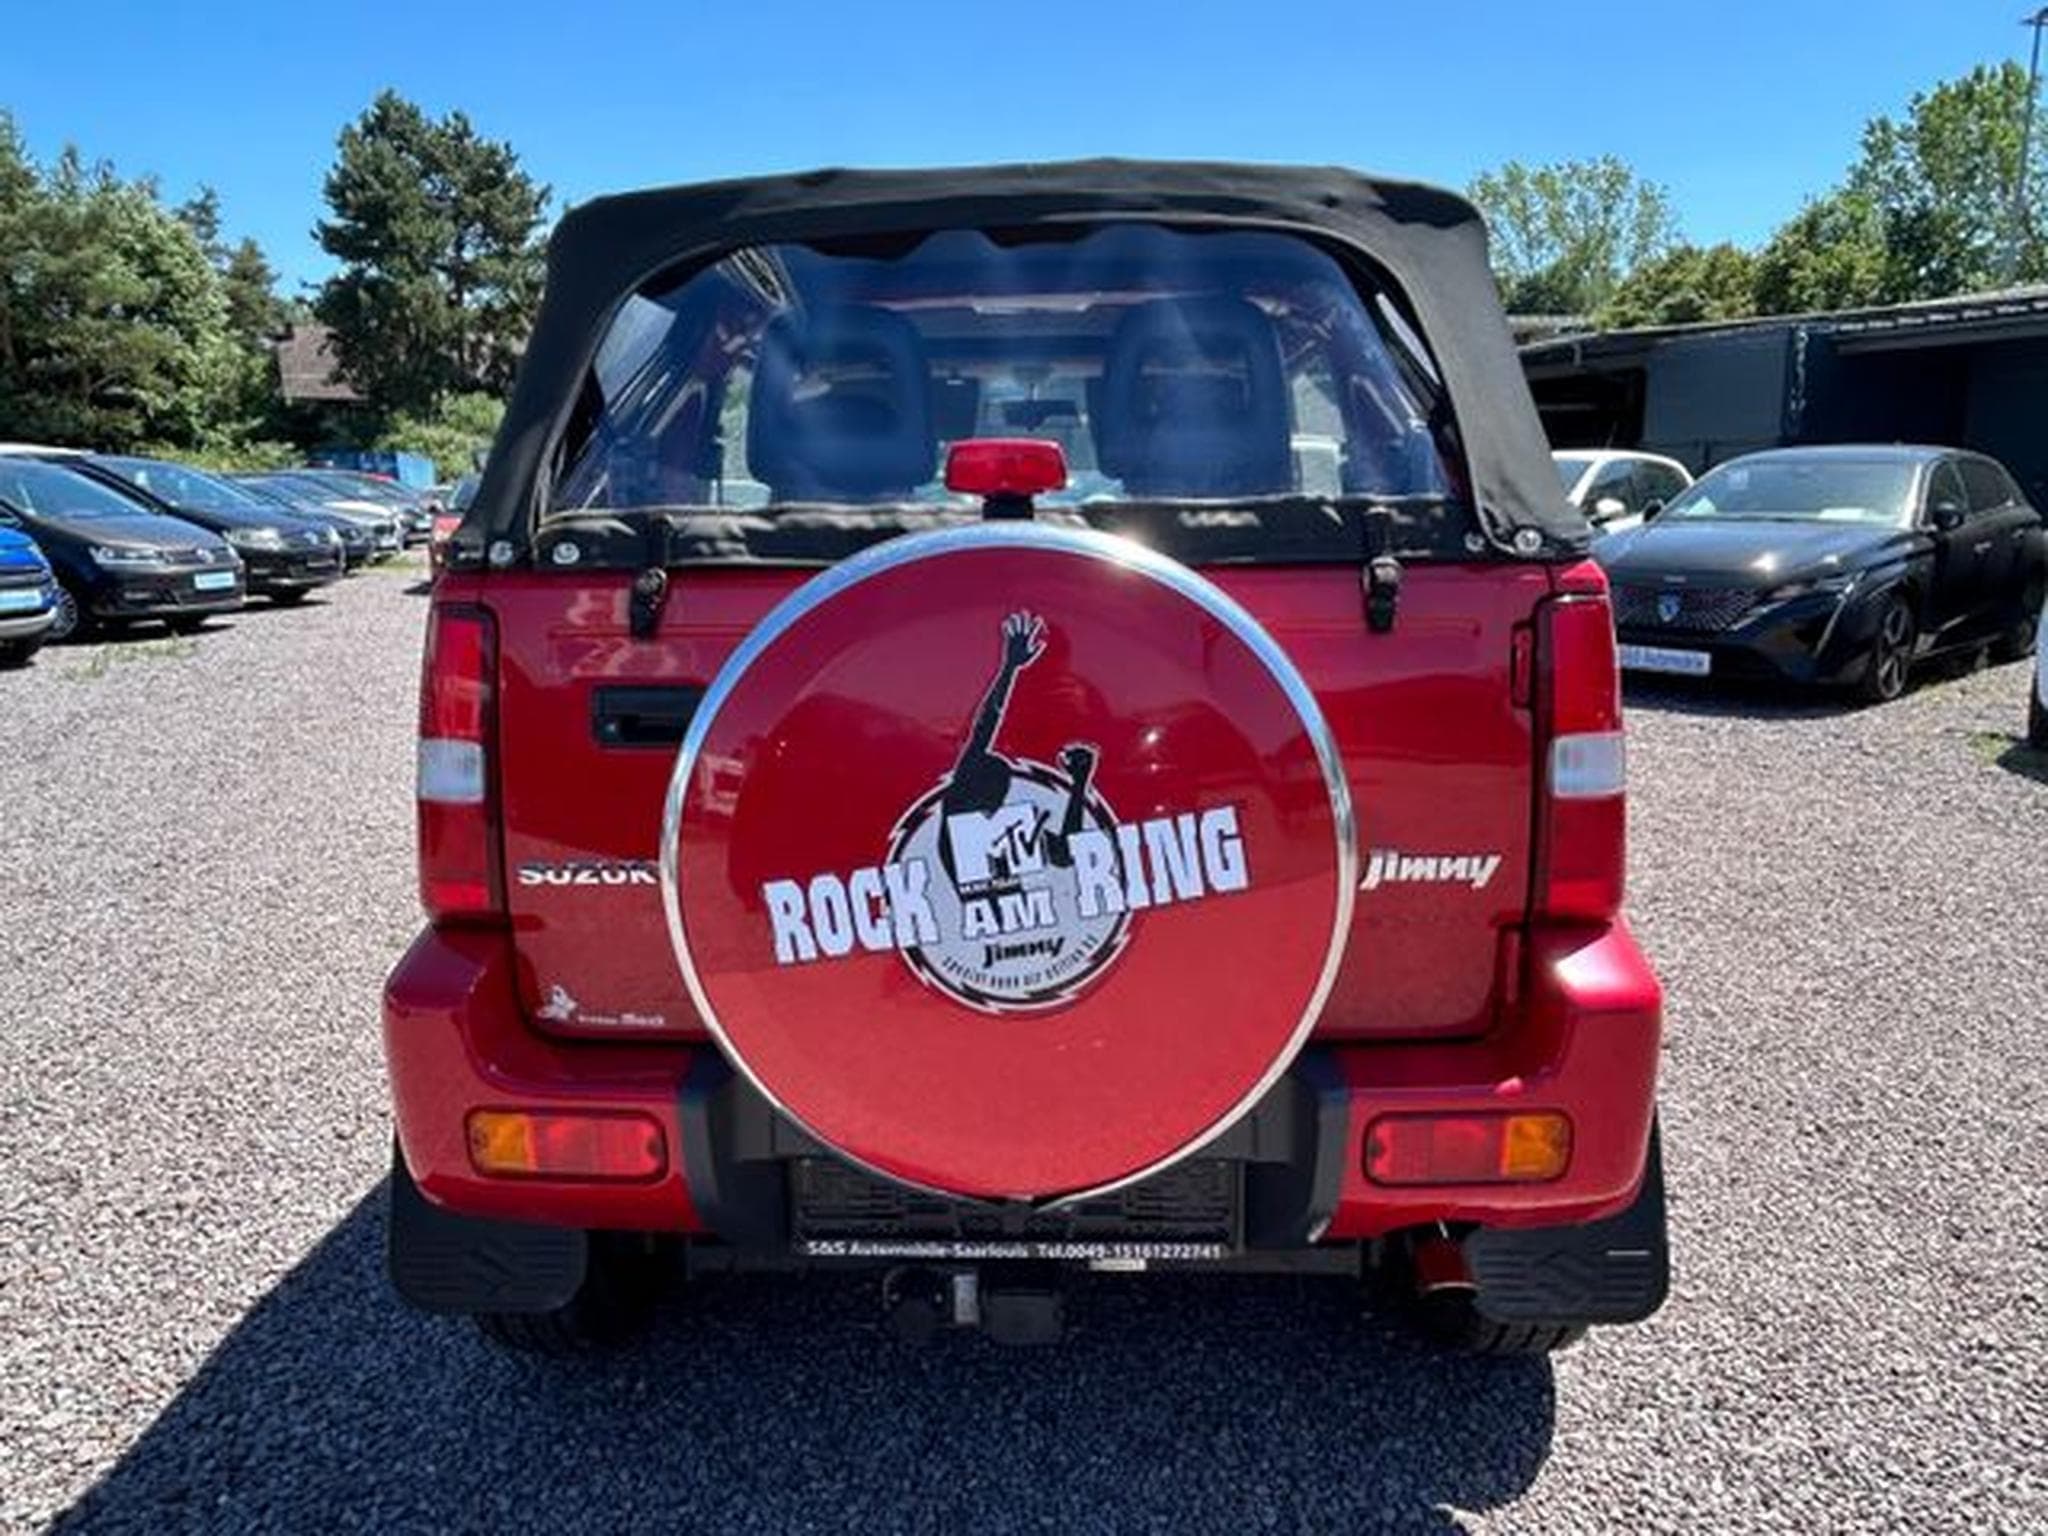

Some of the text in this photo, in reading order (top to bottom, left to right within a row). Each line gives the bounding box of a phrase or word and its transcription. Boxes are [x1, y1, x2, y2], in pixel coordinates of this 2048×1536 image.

[517, 861, 658, 885] SUZUK
[947, 802, 1051, 884] MTV
[762, 806, 1249, 965] ROCK AM RING
